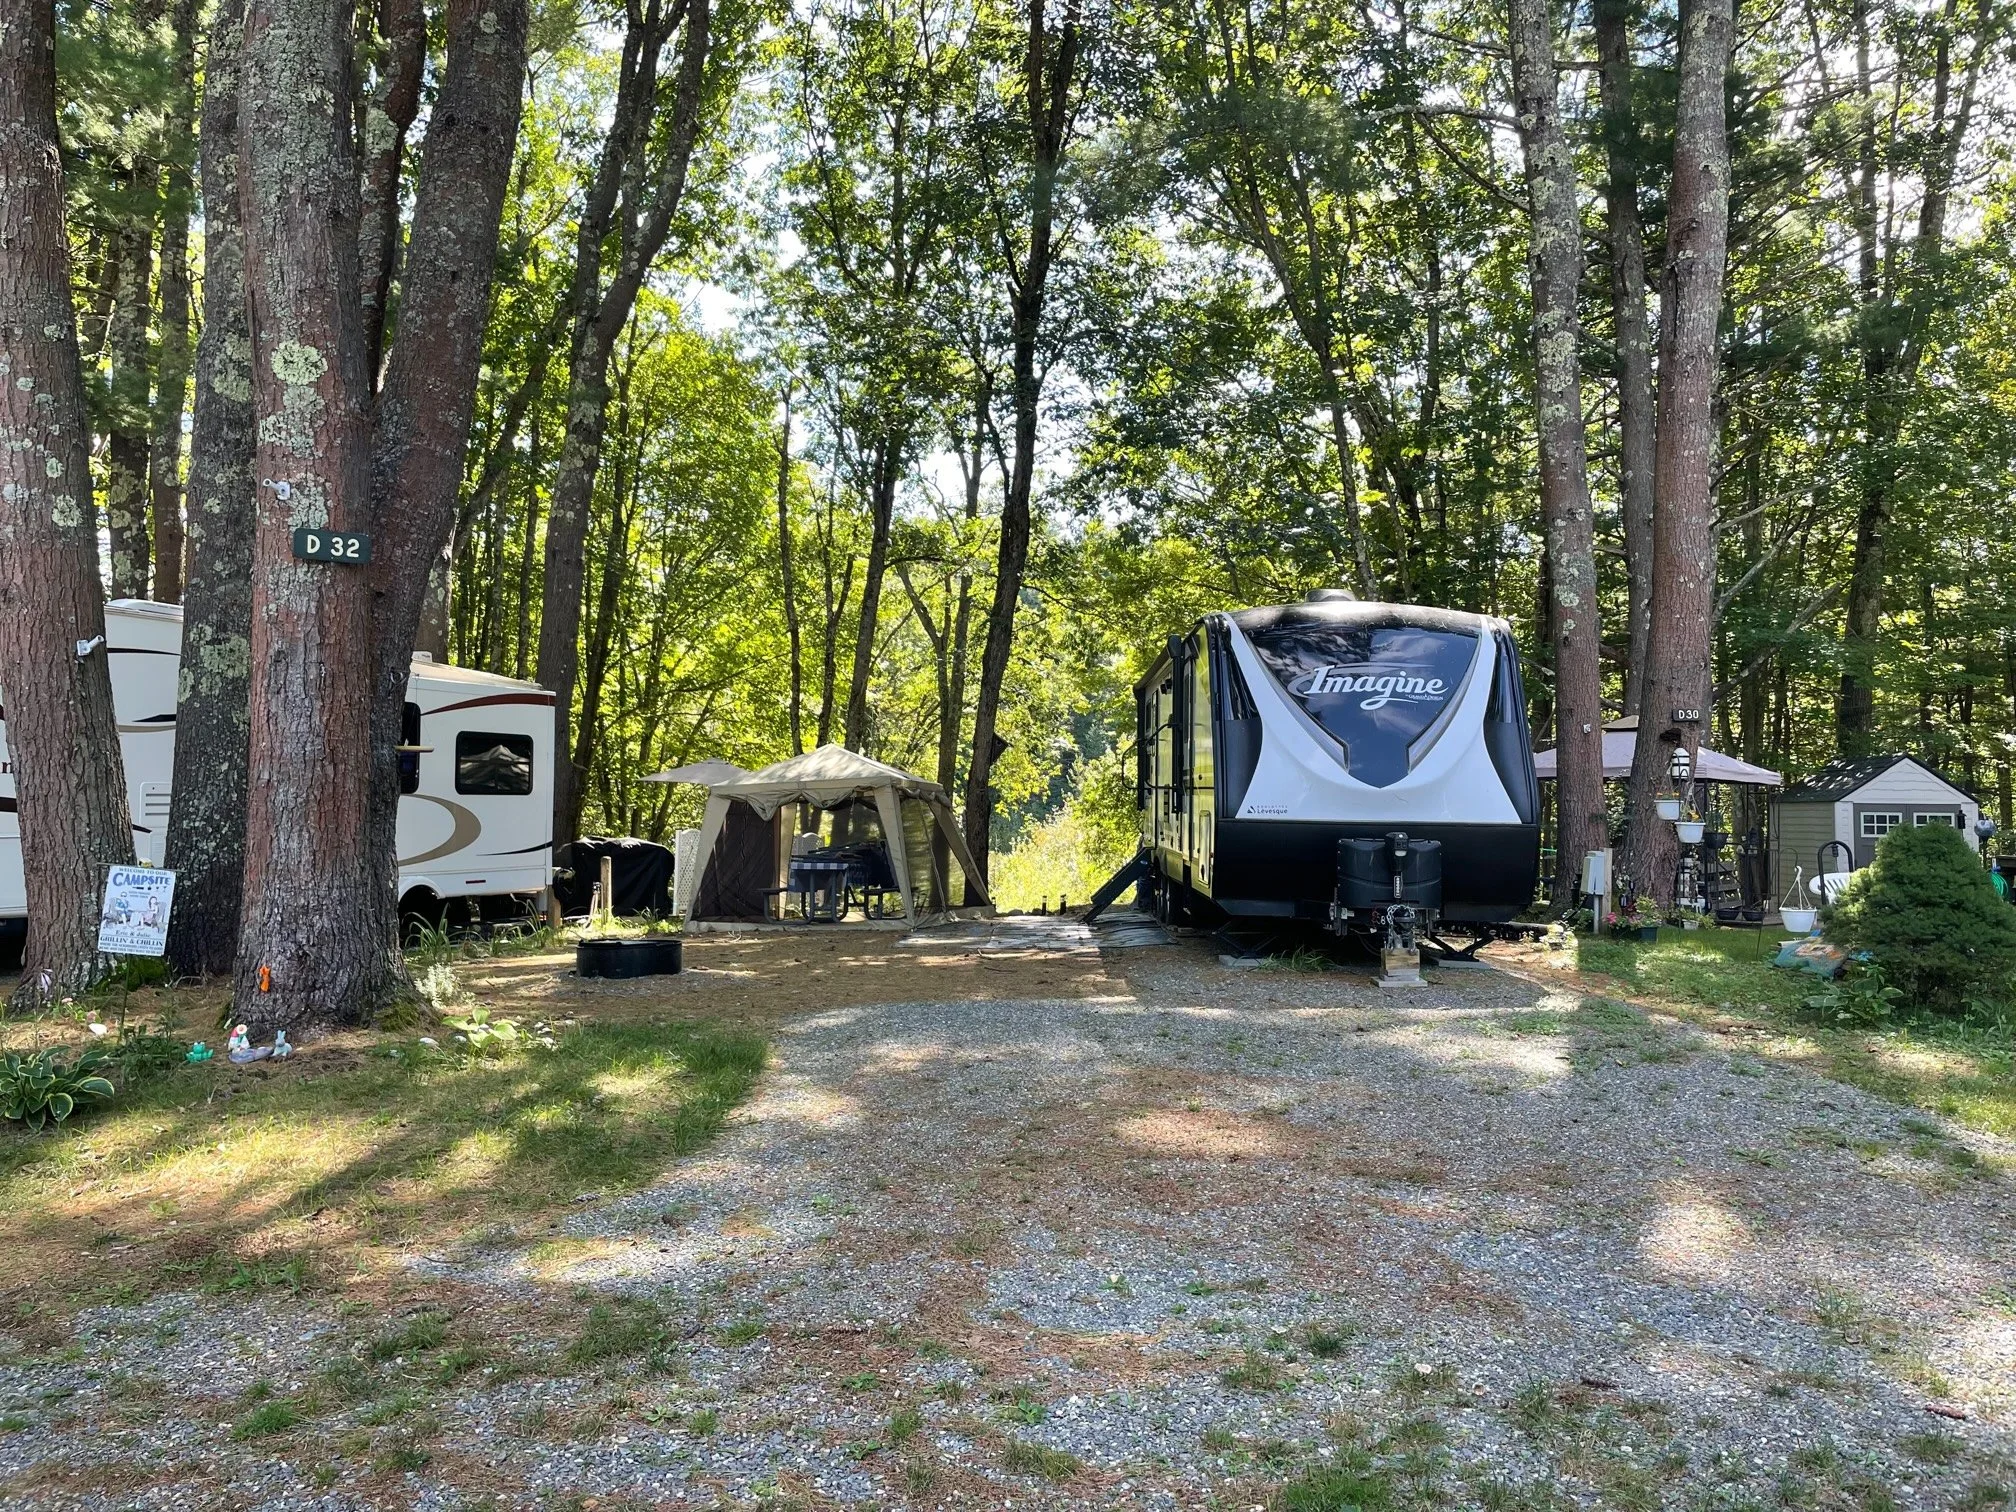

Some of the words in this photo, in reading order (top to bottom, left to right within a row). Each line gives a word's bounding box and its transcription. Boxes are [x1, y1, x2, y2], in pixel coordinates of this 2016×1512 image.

[306, 534, 321, 554] D
[330, 536, 360, 558] 32
[1304, 664, 1450, 711] Imagine
[1678, 709, 1699, 719] D30
[112, 872, 171, 887] CAMPSITE
